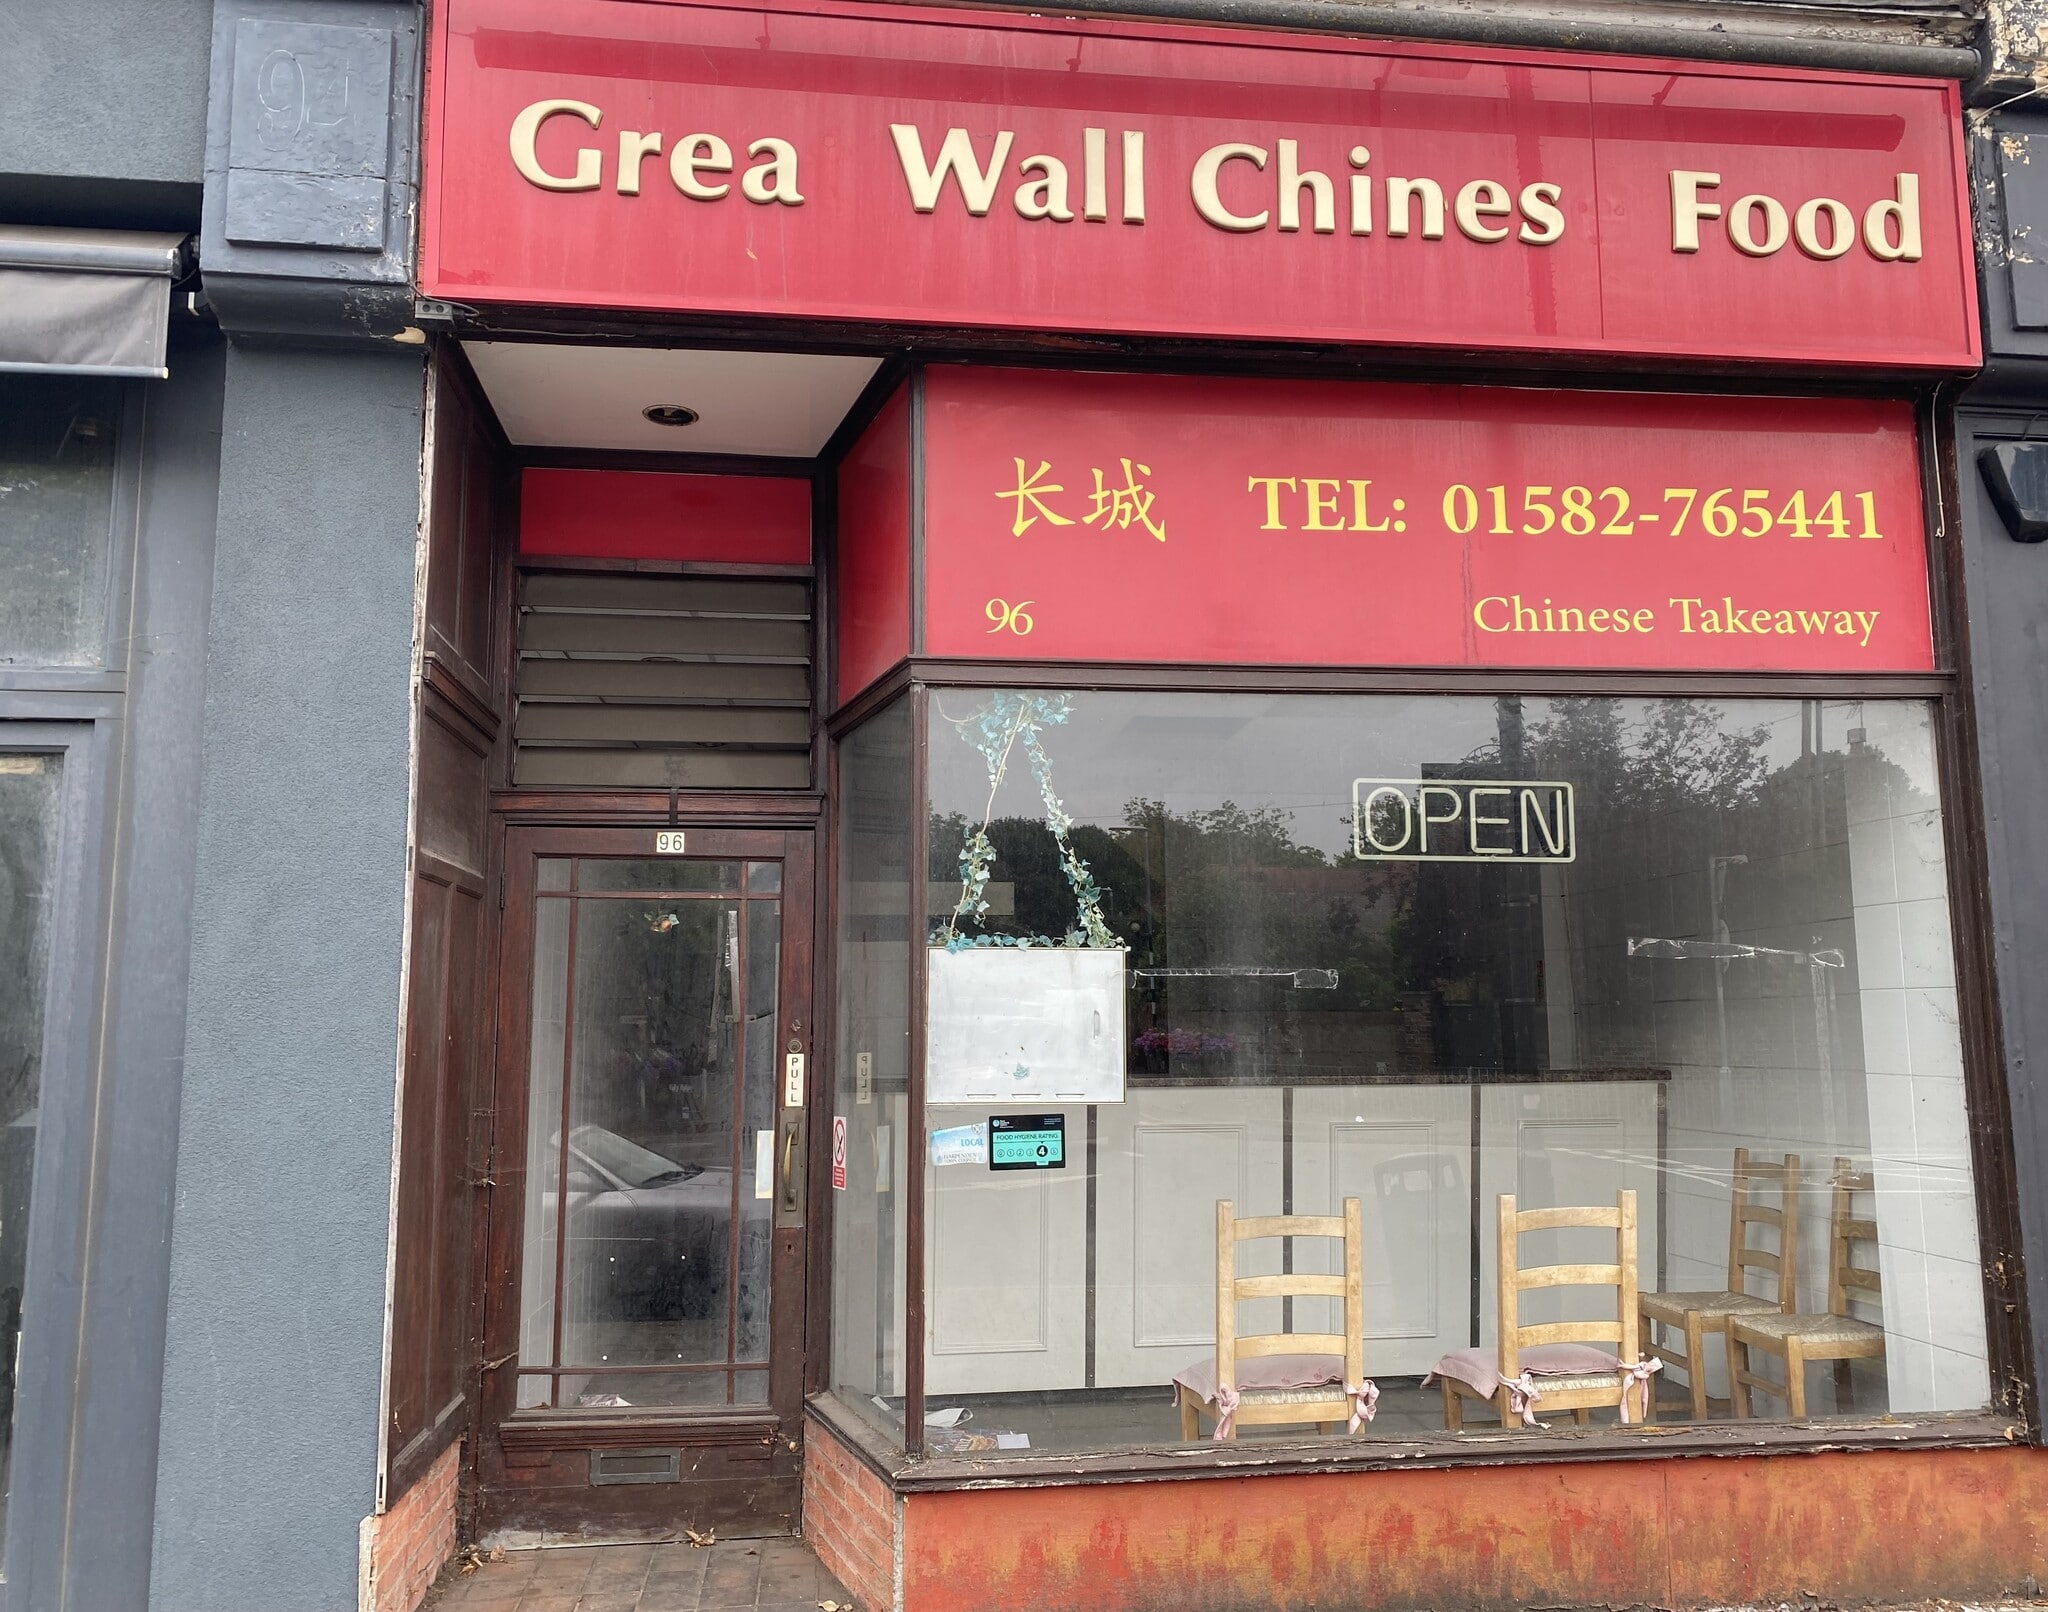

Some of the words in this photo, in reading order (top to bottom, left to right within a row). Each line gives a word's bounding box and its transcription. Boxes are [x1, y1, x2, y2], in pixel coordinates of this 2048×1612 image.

[509, 98, 804, 206] Grea
[889, 123, 1146, 225] Wall
[1190, 138, 1567, 246] Chines
[1669, 169, 1924, 263] Food
[995, 457, 1167, 543] 长城
[1247, 475, 1407, 533] TEL:
[1442, 484, 1884, 540] 01582-765441
[984, 598, 1036, 636] 96
[1473, 595, 1655, 634] Chinese
[1669, 597, 1881, 648] Takeaway
[659, 834, 682, 851] 96
[1364, 786, 1566, 855] OPEN
[790, 1057, 799, 1103] PULL
[960, 1138, 984, 1147] LOCAL
[1038, 1146, 1046, 1156] 4
